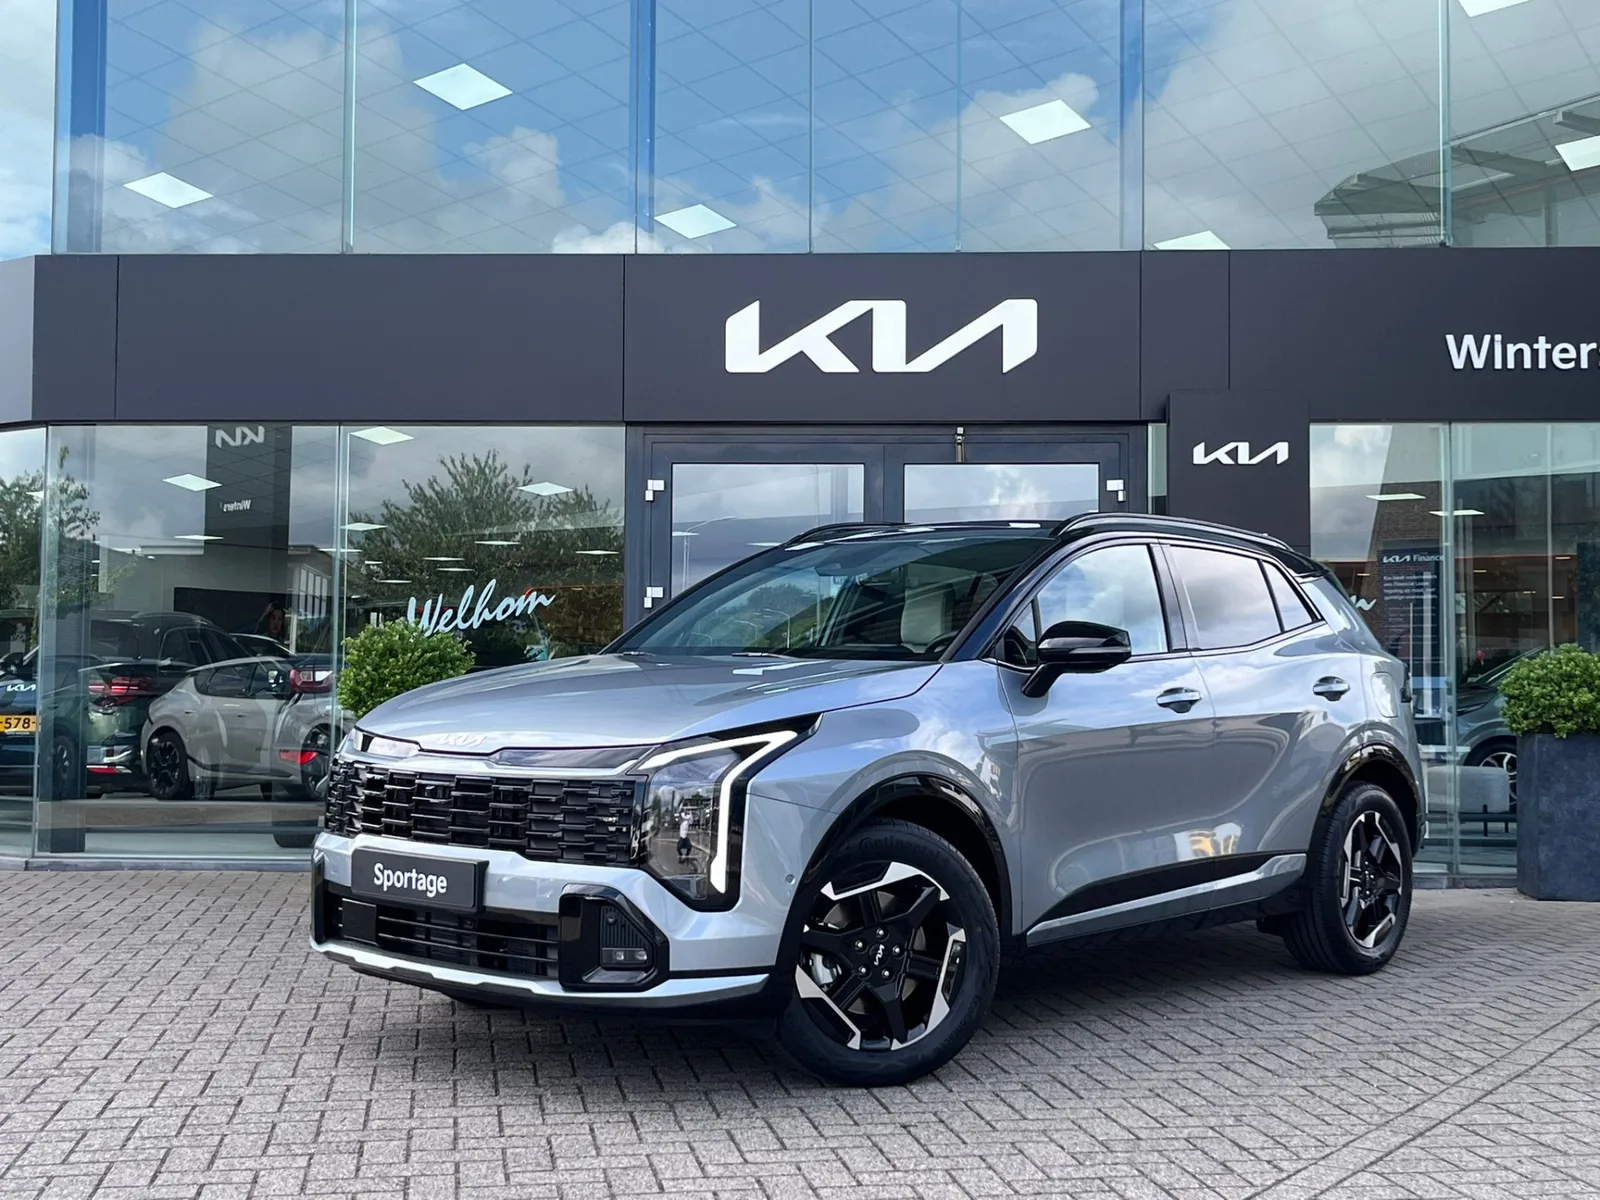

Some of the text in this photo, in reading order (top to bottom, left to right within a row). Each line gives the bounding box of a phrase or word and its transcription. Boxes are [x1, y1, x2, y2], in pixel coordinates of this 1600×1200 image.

[725, 299, 1038, 374] KIA
[1445, 334, 1600, 369] Winter
[1193, 441, 1289, 464] KIA
[1382, 554, 1444, 563] KIA Finance
[373, 863, 447, 898] Sportage
